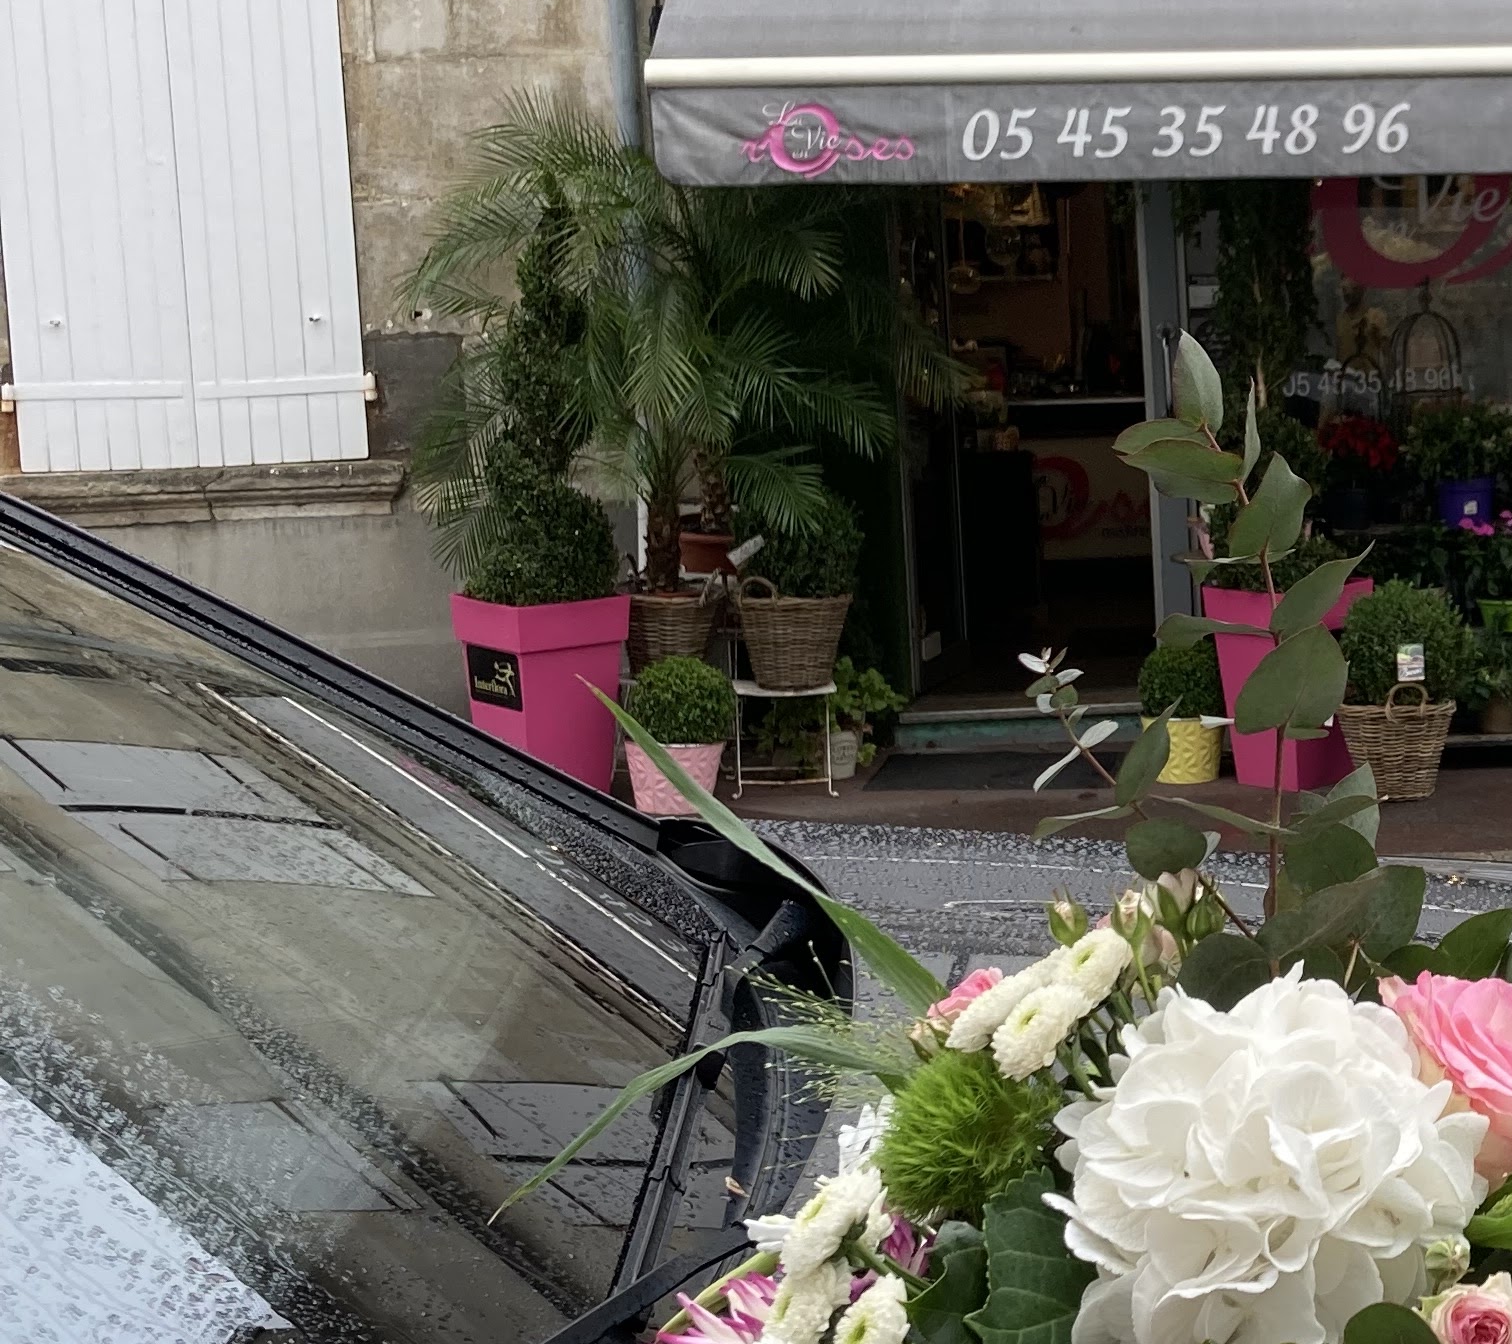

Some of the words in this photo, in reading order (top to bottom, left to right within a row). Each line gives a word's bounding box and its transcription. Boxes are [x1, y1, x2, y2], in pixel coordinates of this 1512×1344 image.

[791, 125, 843, 152] Vie
[962, 108, 1037, 161] 05
[1056, 106, 1132, 158] 45
[1152, 105, 1227, 157] 35
[1246, 103, 1320, 156] 48
[1342, 102, 1412, 154] 96
[1354, 369, 1385, 395] 35
